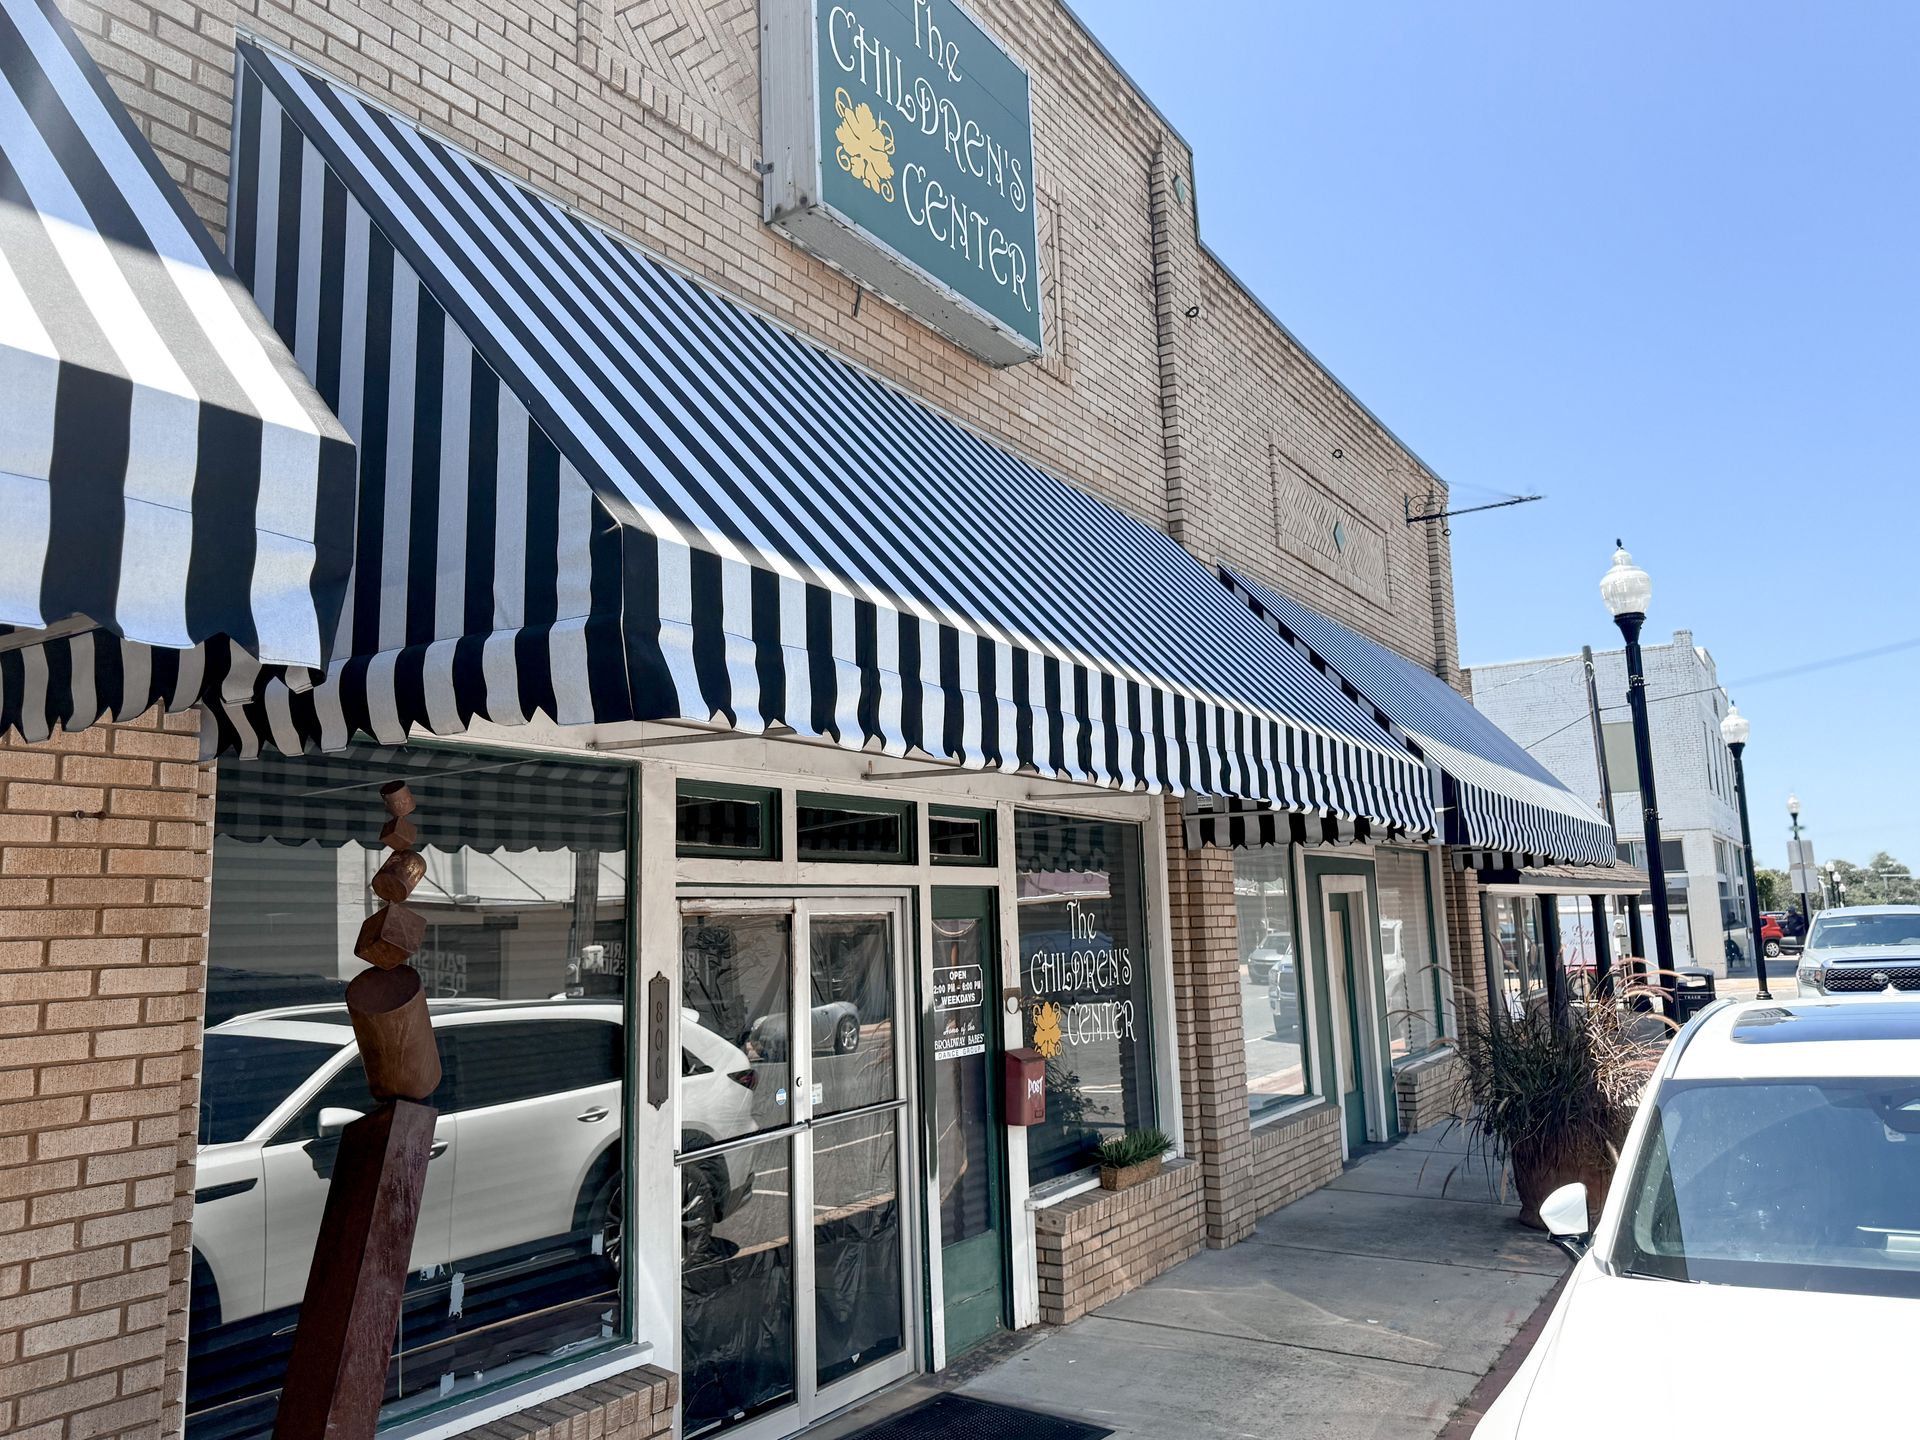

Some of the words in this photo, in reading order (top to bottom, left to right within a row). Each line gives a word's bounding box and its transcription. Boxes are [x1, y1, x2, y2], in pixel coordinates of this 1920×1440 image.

[911, 0, 963, 83] The
[1066, 899, 1097, 944] The
[949, 970, 967, 980] OPEN
[947, 982, 956, 993] PM
[962, 981, 973, 991] 6:00
[974, 980, 982, 990] PM
[940, 992, 976, 1006] WEEKDAYS
[960, 1022, 967, 1036] of
[934, 1036, 966, 1050] BROADWAY
[938, 1050, 960, 1060] DANCE
[1028, 1075, 1043, 1100] POST
